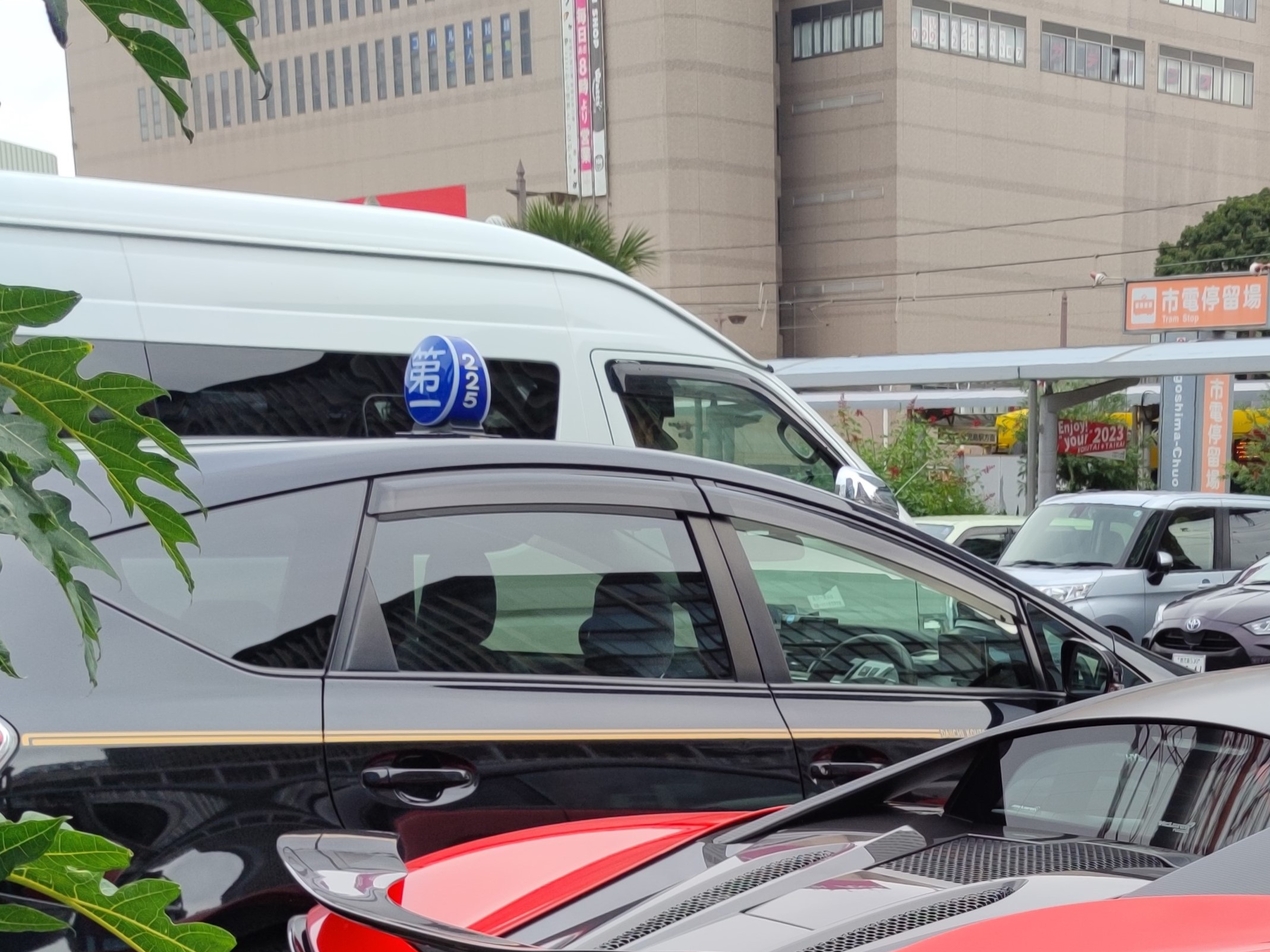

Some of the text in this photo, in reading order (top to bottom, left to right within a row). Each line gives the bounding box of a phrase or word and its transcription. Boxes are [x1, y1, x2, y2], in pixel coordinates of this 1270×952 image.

[1160, 283, 1262, 314] 市電停留場
[1162, 313, 1200, 324] Tram Stop
[408, 345, 447, 409] 第一
[461, 353, 480, 409] 225
[1058, 420, 1088, 436] Enjoy!
[1092, 425, 1125, 444] 2023
[1171, 375, 1184, 489] goshima-Chuo
[1205, 377, 1225, 491] 市電停留場
